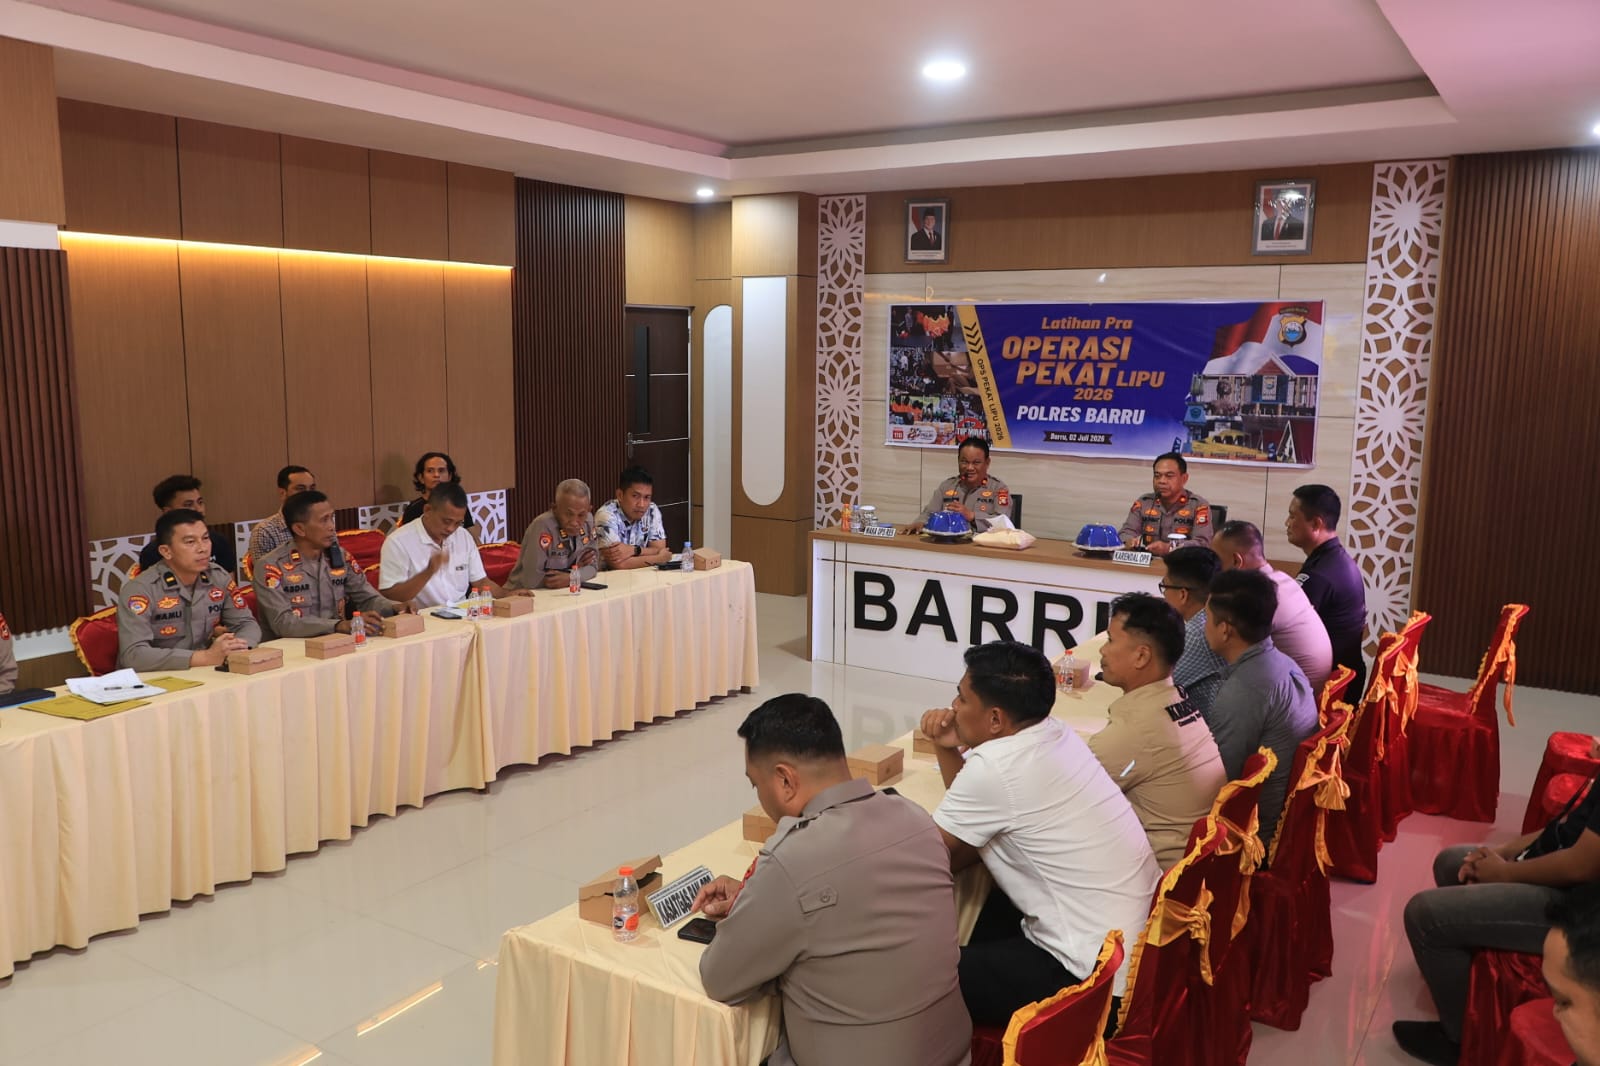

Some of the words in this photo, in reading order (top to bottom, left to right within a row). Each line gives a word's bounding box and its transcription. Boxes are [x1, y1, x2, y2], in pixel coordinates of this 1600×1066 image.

[1041, 316, 1101, 330] Latihan
[1104, 316, 1133, 330] Pra
[1001, 335, 1132, 361] OPERASI
[977, 358, 987, 376] OPS
[1015, 361, 1118, 386] PEKAT
[1115, 369, 1166, 388] LIPU
[981, 376, 994, 401] PEKAT
[1073, 387, 1114, 401] 2026
[988, 402, 999, 422] LIPU
[1016, 405, 1082, 422] POLRES
[1084, 407, 1146, 425] BARRU
[994, 423, 1005, 441] 2026
[1115, 552, 1138, 562] KARENDAL
[1139, 554, 1151, 563] OPS
[655, 887, 693, 925] KASATGAS
